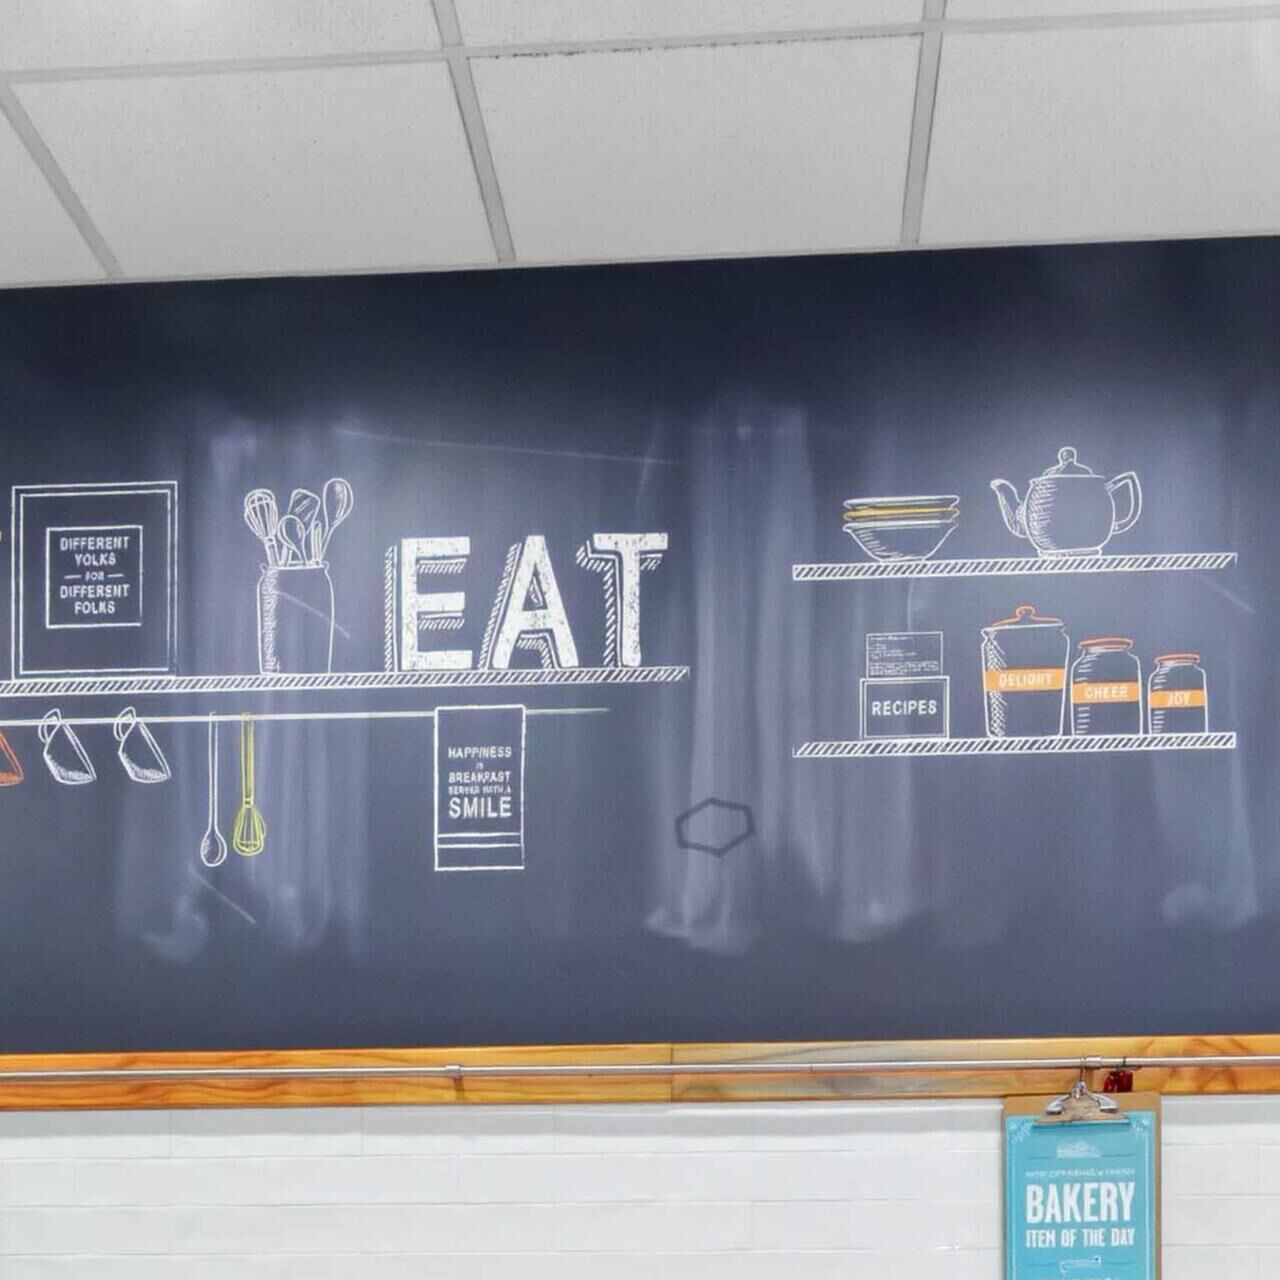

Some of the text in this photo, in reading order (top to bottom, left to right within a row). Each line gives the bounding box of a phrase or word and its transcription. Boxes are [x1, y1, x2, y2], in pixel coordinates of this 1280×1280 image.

[60, 536, 130, 551] DIFFERENT
[74, 553, 116, 567] YOLKS
[60, 584, 130, 599] DIFFERENT
[74, 601, 116, 615] FOLKS
[385, 532, 669, 671] EAT
[998, 672, 1054, 687] DELIGHT
[1084, 685, 1128, 699] CHEER
[1167, 692, 1191, 705] JOY
[871, 700, 938, 716] RECIPES
[448, 746, 512, 759] HAPPINESS
[448, 771, 511, 783] BREAKFAST
[448, 797, 512, 818] SMILE
[1026, 1181, 1135, 1224] BAKERY
[1026, 1227, 1135, 1248] ITEM OF THE DAY
